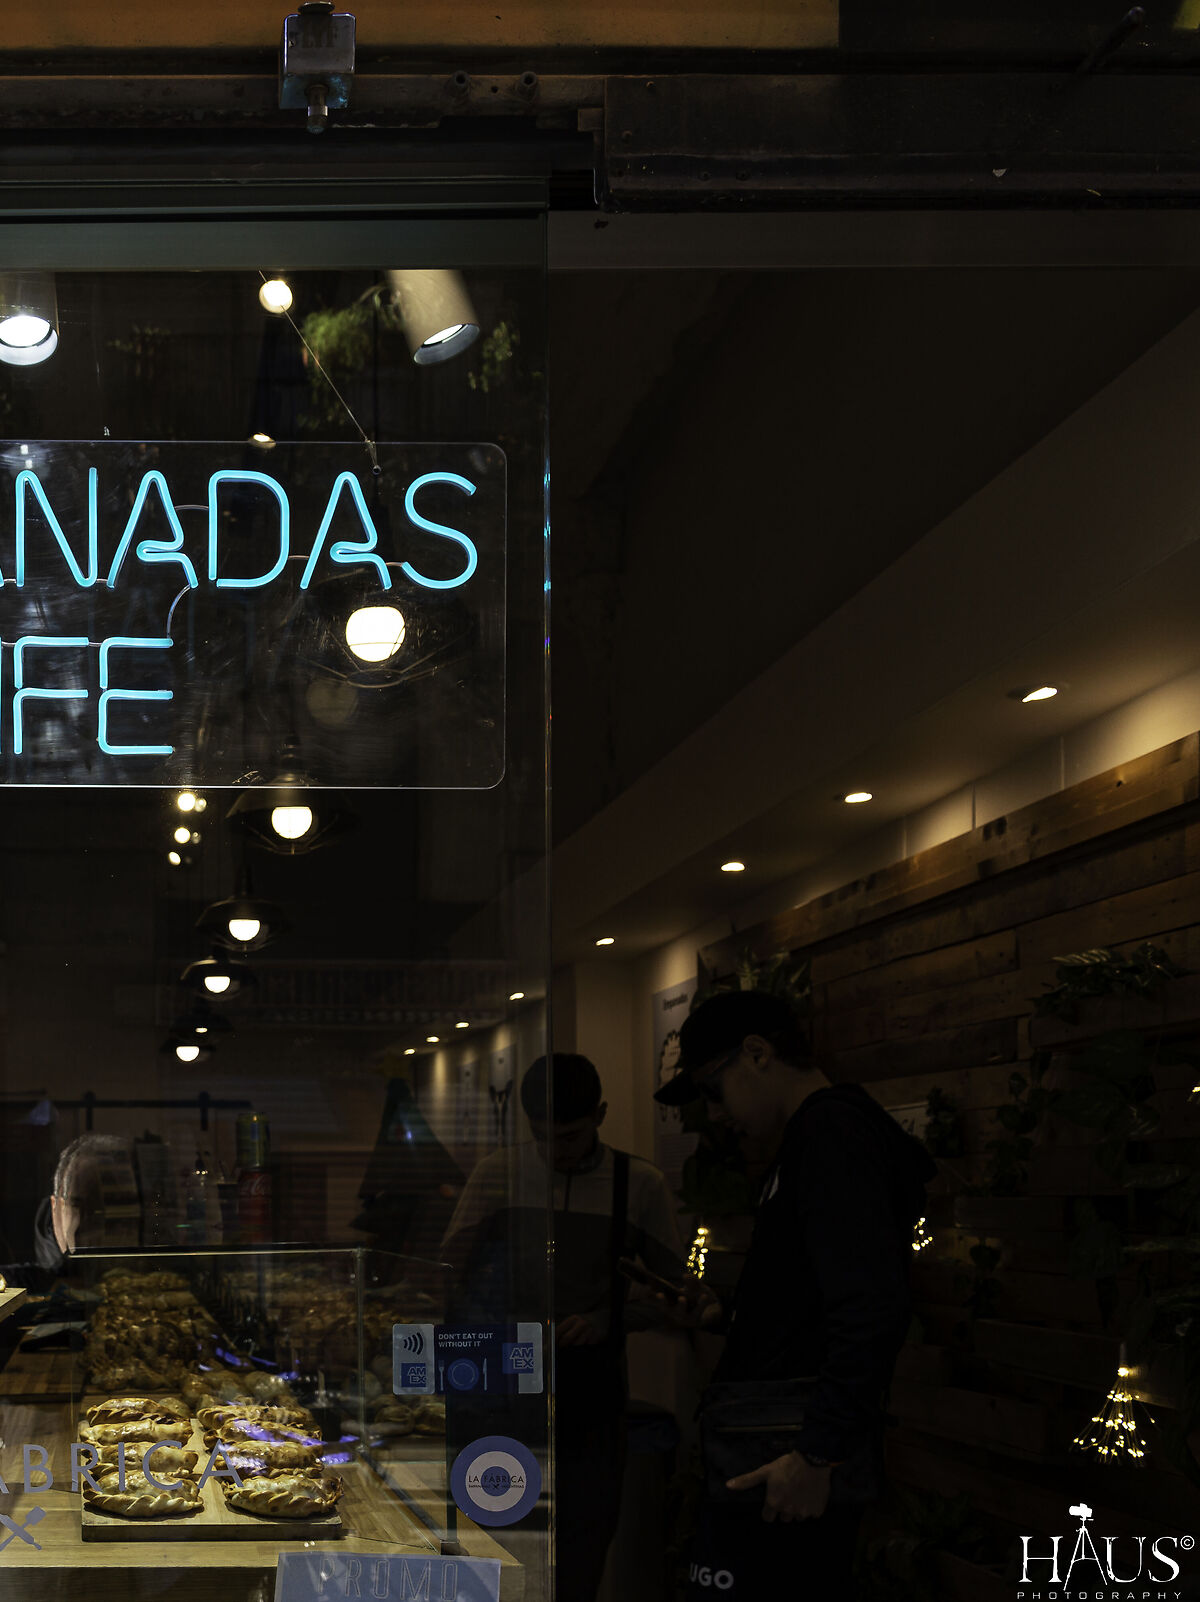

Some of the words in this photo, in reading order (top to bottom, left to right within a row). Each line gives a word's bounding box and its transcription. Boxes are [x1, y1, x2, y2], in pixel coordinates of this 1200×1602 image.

[438, 1332, 461, 1340] DON'T
[462, 1332, 477, 1340] EAT
[317, 1559, 457, 1602] PROMO
